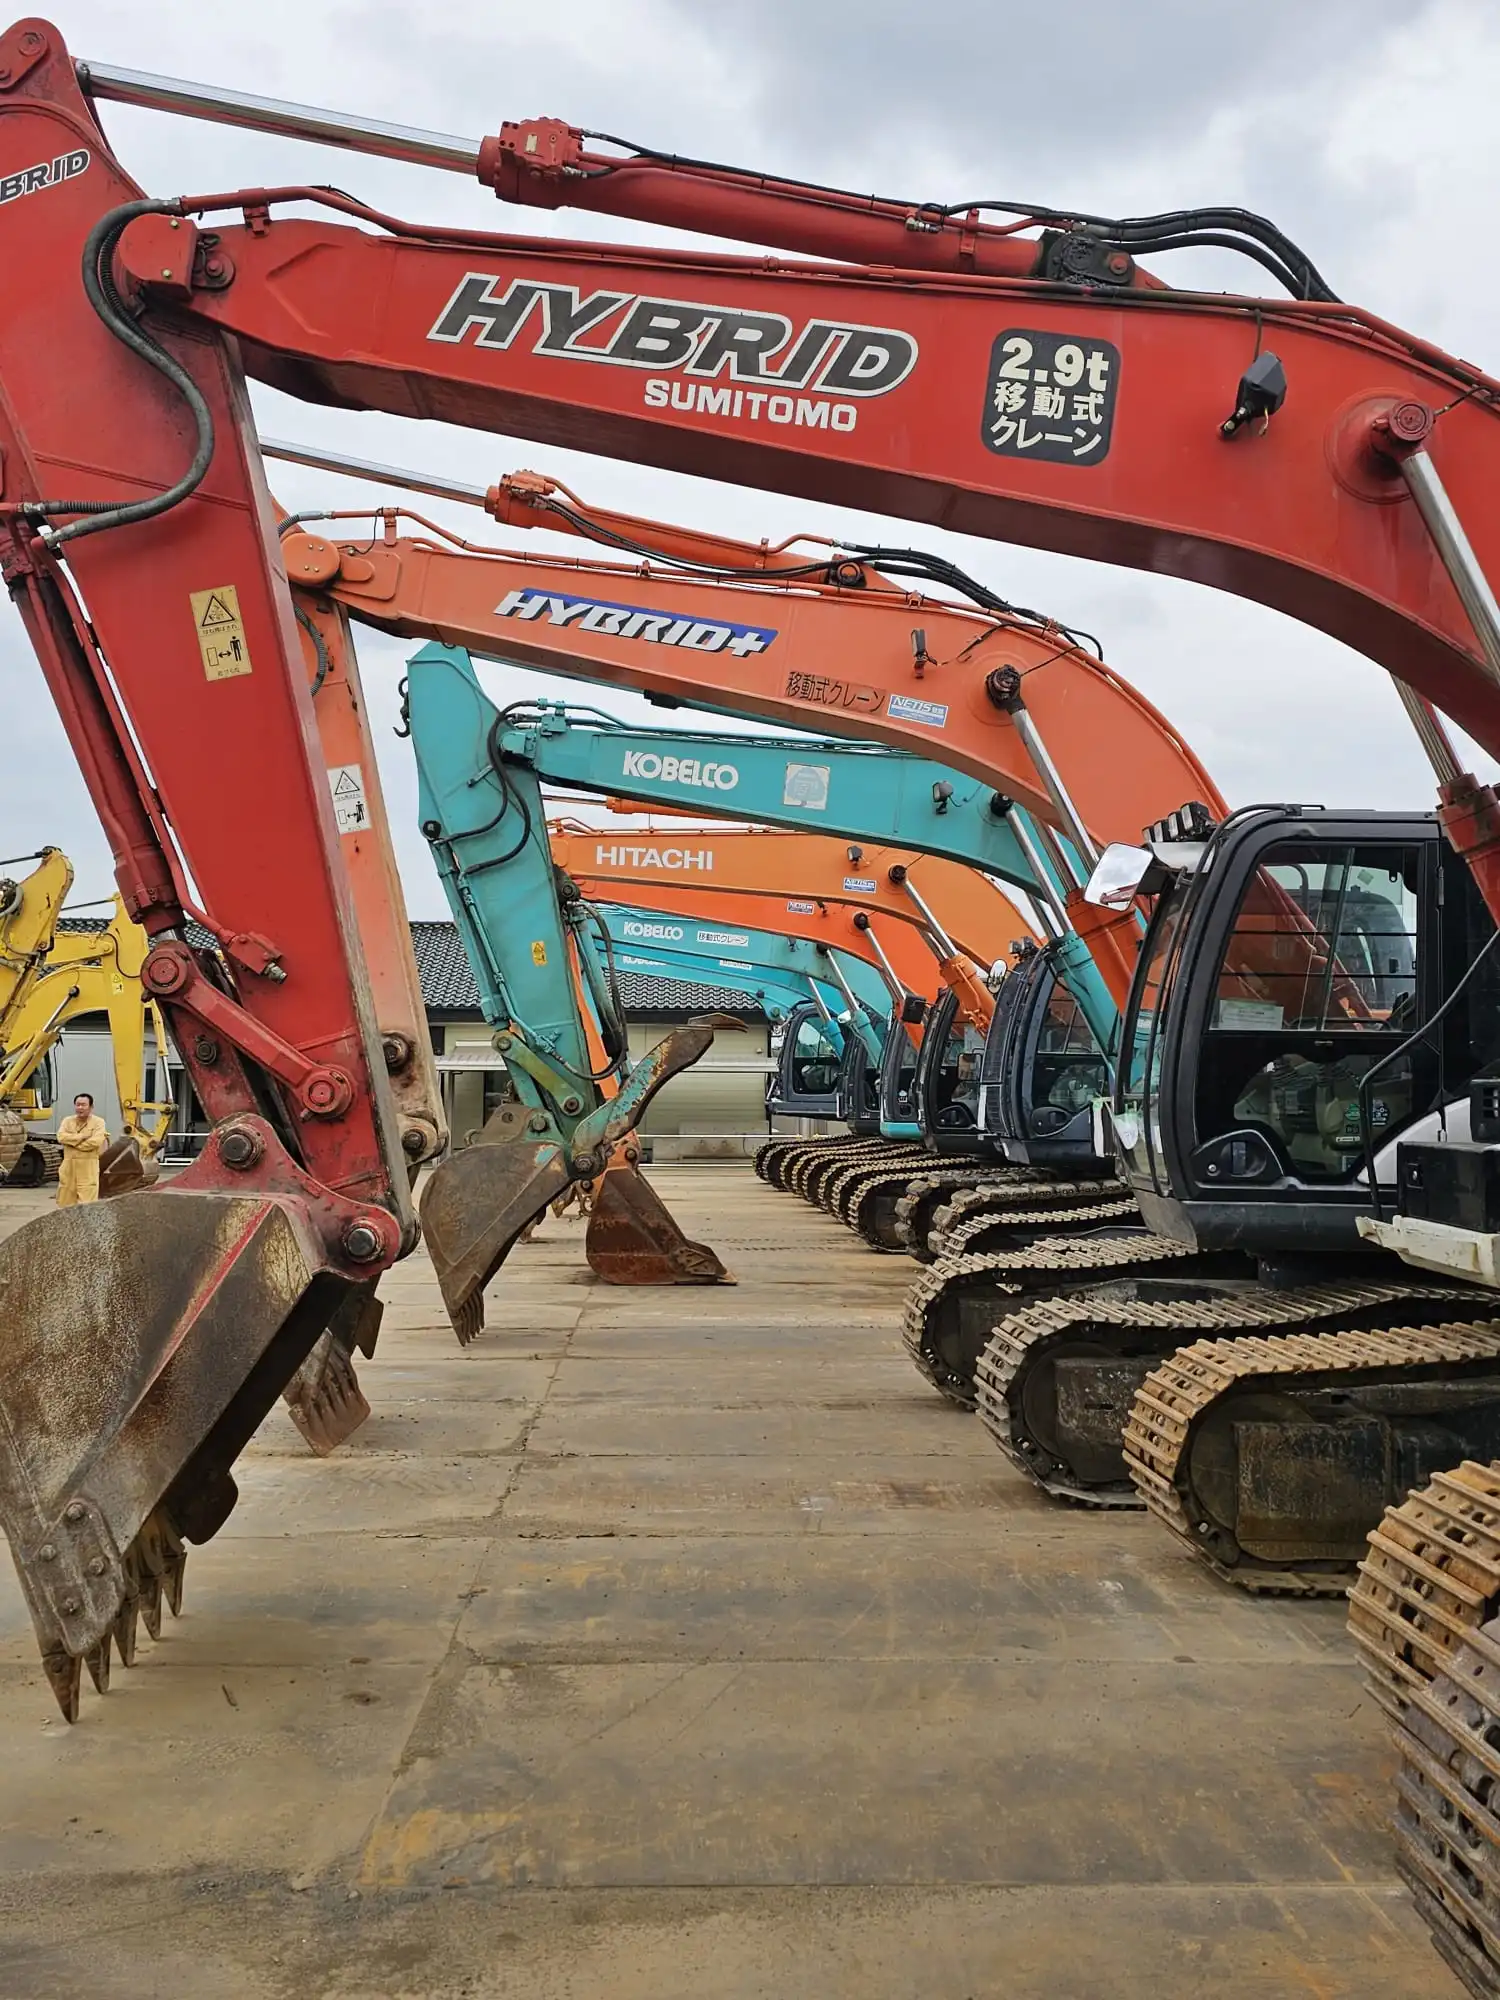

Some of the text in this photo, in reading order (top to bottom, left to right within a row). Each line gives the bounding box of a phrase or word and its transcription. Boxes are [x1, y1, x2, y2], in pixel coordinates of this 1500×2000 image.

[426, 272, 919, 397] HYBRID
[999, 337, 1109, 392] 2.9t
[644, 379, 858, 431] SUMITOMO
[993, 380, 1105, 425] 移動式
[990, 415, 1102, 457] クレーン
[785, 671, 886, 713] 移動式クレーン
[893, 696, 932, 714] NETIS
[623, 750, 739, 790] KOBELCO
[596, 845, 713, 870] HITACHI
[623, 921, 684, 940] KOBELCO
